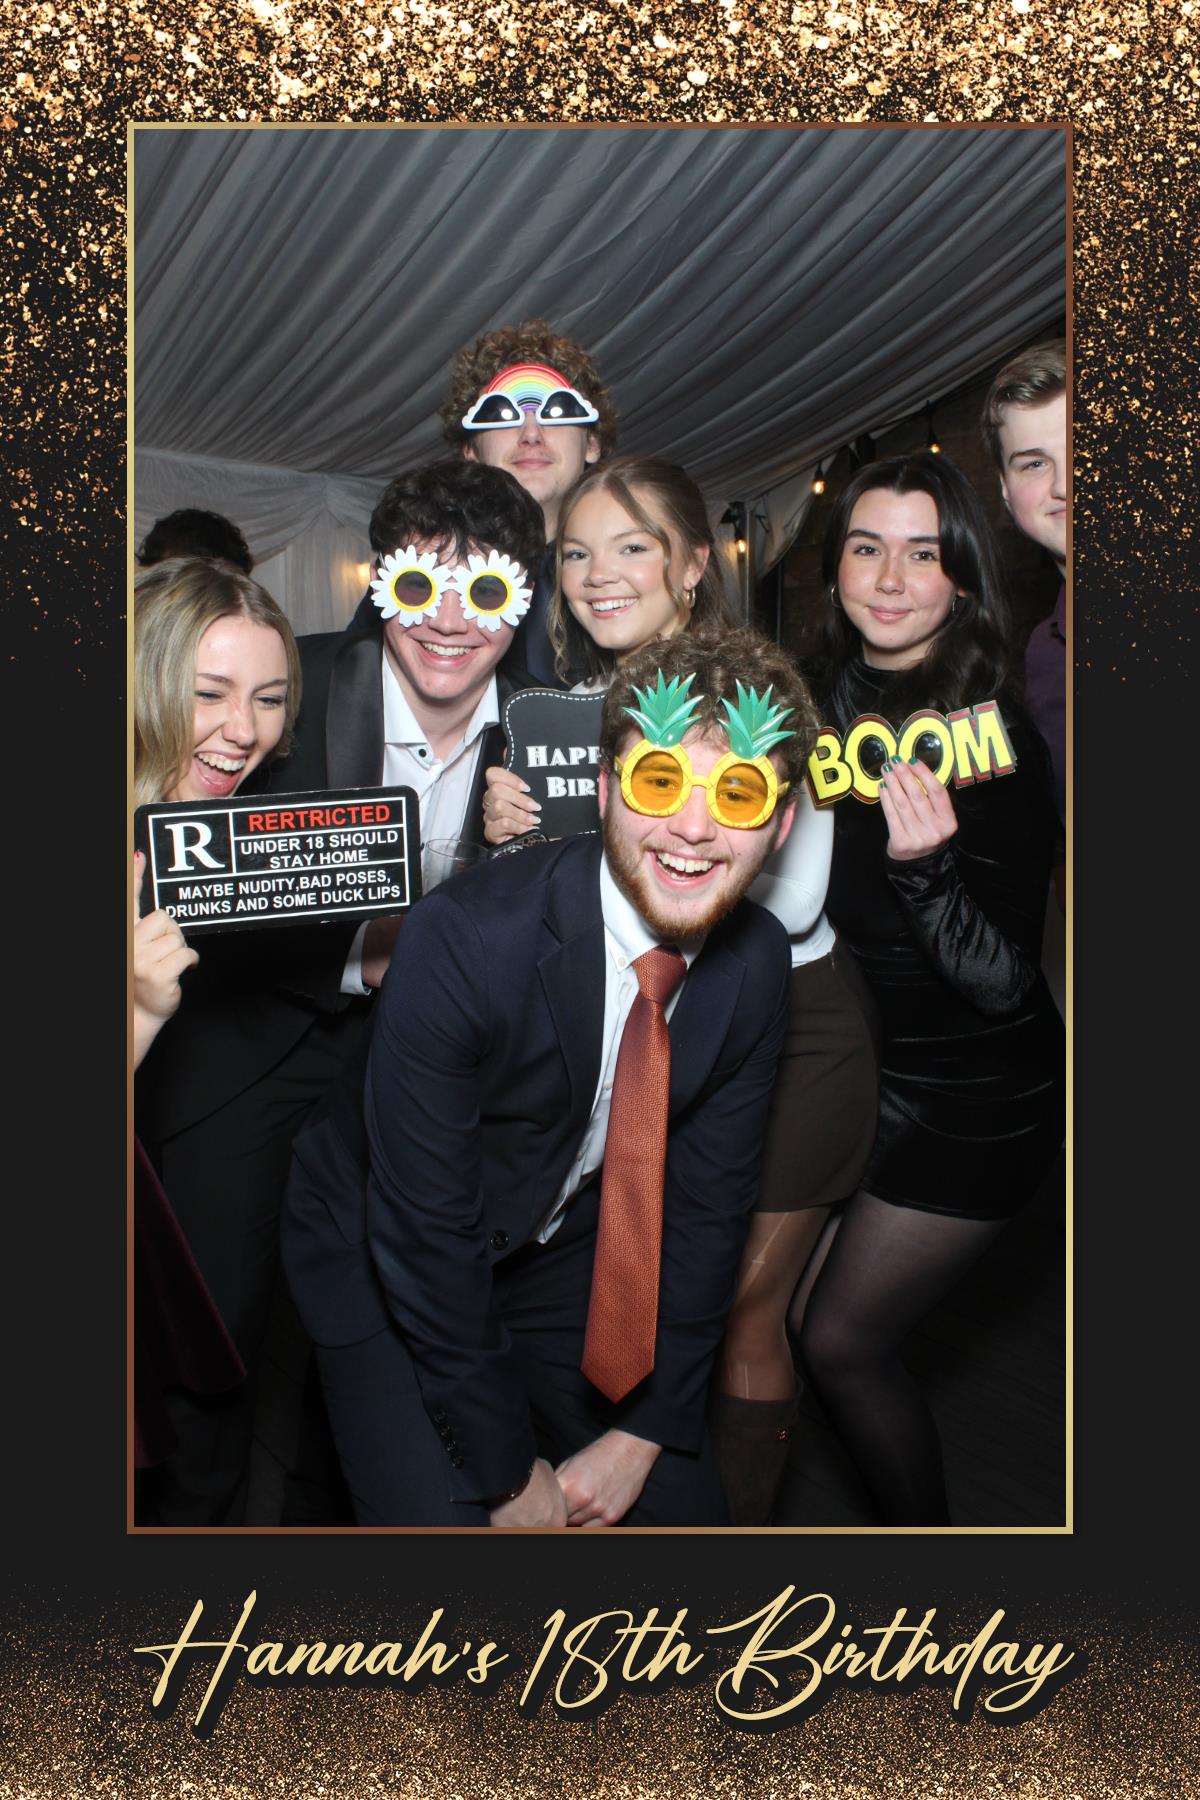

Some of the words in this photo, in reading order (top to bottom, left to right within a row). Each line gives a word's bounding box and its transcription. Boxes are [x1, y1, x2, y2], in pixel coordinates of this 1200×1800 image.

[526, 745, 601, 767] HAPP
[806, 701, 1014, 804] BOOM
[546, 776, 599, 798] BIR
[248, 804, 390, 832] RERTRICTED
[164, 821, 225, 872] R
[240, 838, 301, 855] UNDER
[305, 835, 325, 850] 18
[329, 830, 398, 848] SHOULD
[269, 853, 315, 869] STAY
[319, 850, 368, 866] HOME
[178, 883, 234, 900] MAYBE
[336, 869, 391, 885] POSES,
[165, 901, 231, 919] DRUNKS
[235, 895, 269, 912] AND
[273, 892, 317, 909] SOME
[321, 888, 364, 904] DUCK
[368, 885, 400, 900] LIPS
